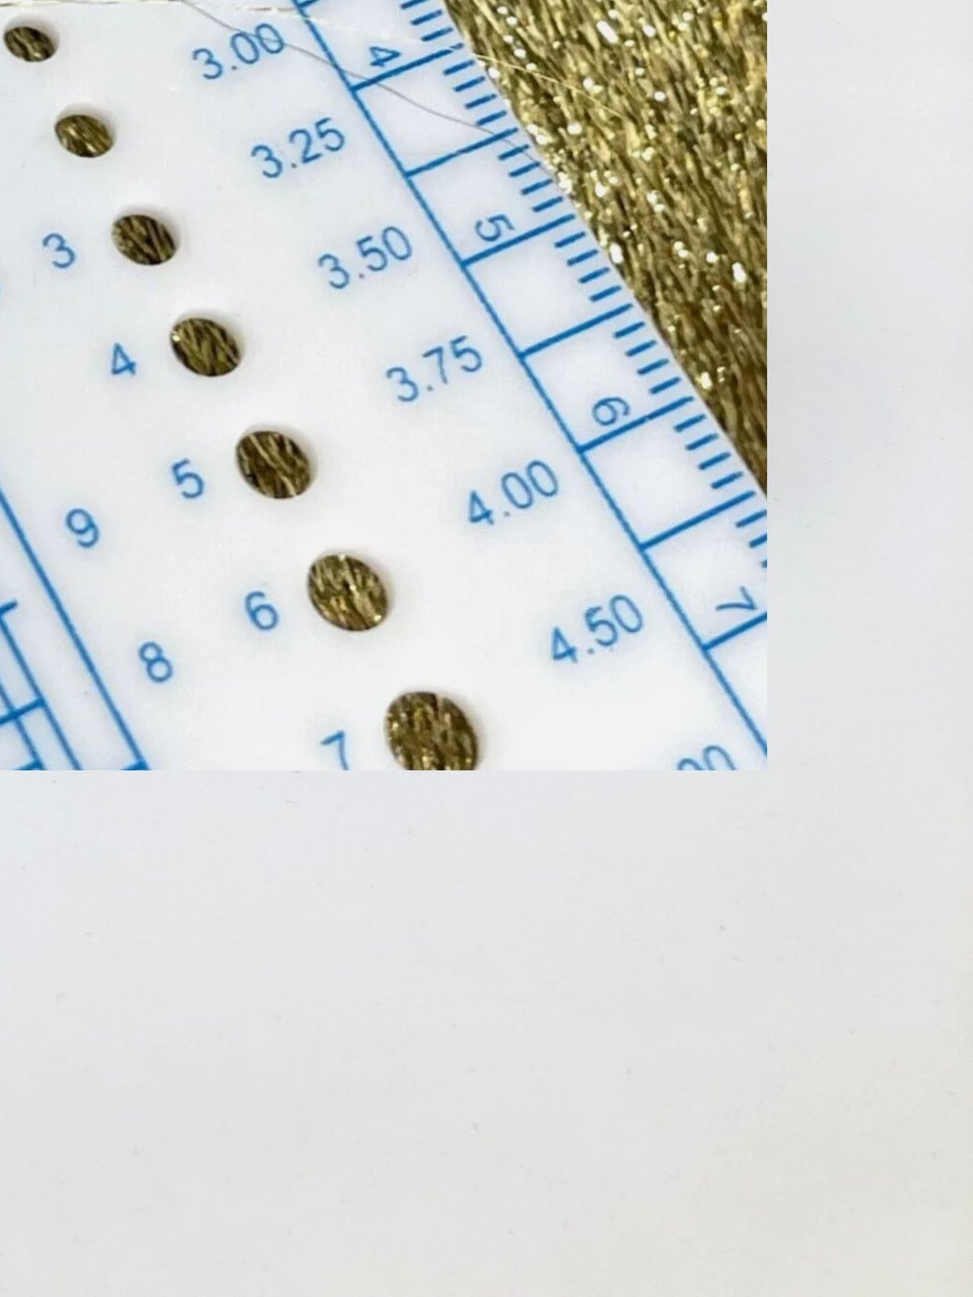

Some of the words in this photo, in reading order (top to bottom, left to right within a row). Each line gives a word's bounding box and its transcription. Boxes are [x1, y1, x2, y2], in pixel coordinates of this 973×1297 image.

[192, 23, 286, 79] 3.00
[368, 44, 401, 68] 4
[252, 117, 346, 179] 3.25
[474, 212, 515, 243] 5
[43, 233, 77, 269] 3
[318, 227, 413, 290] 3.50
[110, 343, 137, 377] 4
[386, 335, 483, 403] 3.75
[591, 396, 632, 427] 6
[171, 460, 205, 499] 5
[467, 460, 559, 526] 4.00
[64, 508, 100, 549] 9
[244, 591, 280, 632] 6
[716, 587, 758, 614] 7
[550, 594, 643, 664] 4.50
[138, 641, 174, 684] 8
[321, 729, 350, 770] 7
